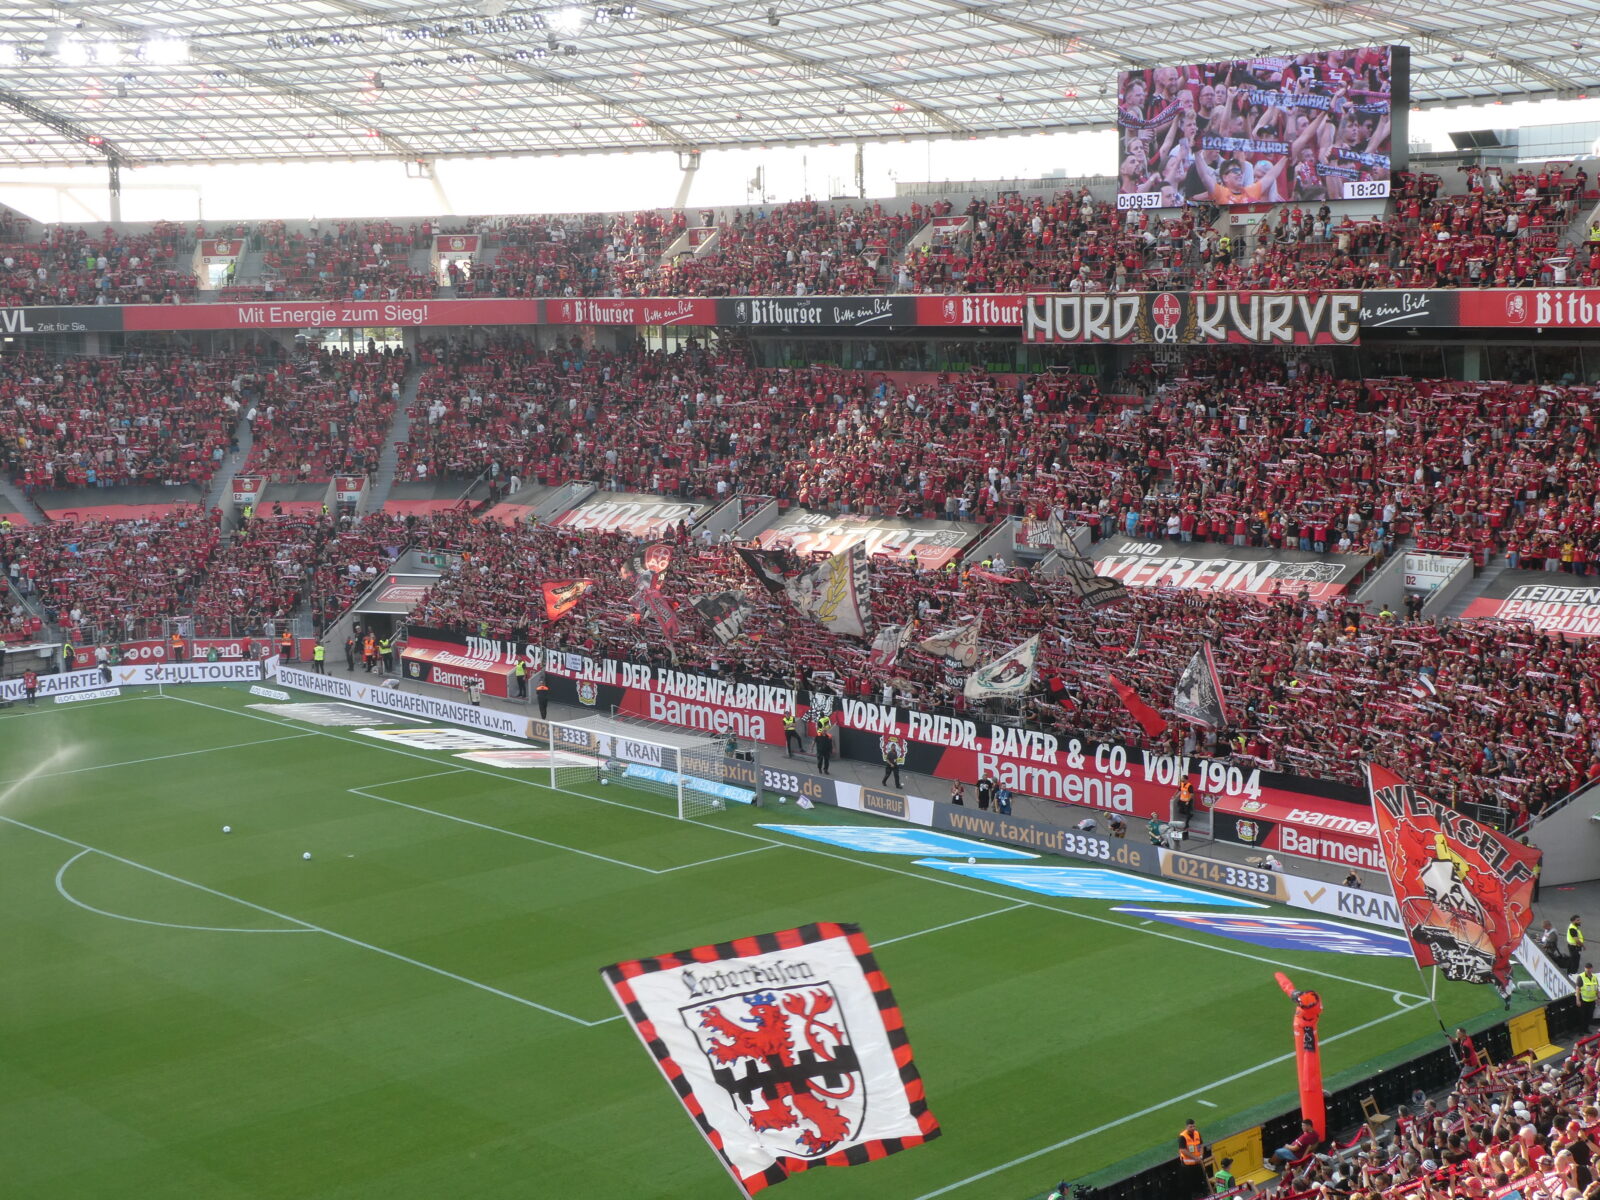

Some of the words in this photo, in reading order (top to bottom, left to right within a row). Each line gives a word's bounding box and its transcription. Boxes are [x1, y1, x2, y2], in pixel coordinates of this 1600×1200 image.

[1350, 183, 1386, 197] 18:20
[1119, 195, 1160, 209] 0:09:57
[574, 300, 635, 323] Bitburger
[643, 307, 663, 324] Bitte
[664, 308, 678, 319] ein
[678, 300, 694, 315] Bit
[751, 299, 822, 325] Bitburger
[833, 306, 856, 324] Bitte
[858, 306, 875, 319] ein
[874, 298, 893, 314] Bit
[1153, 307, 1181, 315] BAYER
[1402, 293, 1430, 312] Bit
[37, 322, 55, 332] Zeit
[56, 322, 70, 332] für
[71, 322, 88, 332] Sie.
[238, 307, 265, 323] Mit
[270, 306, 337, 327] Energie
[342, 311, 378, 322] zum
[383, 304, 429, 324] Sieg!
[1025, 295, 1141, 341] NORD
[1196, 293, 1359, 343] KURVE
[1153, 323, 1179, 344] 04
[796, 513, 832, 526] FÜR
[1118, 542, 1163, 556] UND
[1097, 556, 1282, 592] VEREIN
[1405, 575, 1417, 586] D2
[431, 650, 493, 672] Barmenia
[144, 664, 268, 682] SCHULTOUREN
[280, 669, 352, 698] BOTENFAHRTEN
[432, 665, 485, 692] Barmenia
[370, 688, 482, 726] FLUGHAFENTRANSFER
[483, 714, 517, 733] u.v.m.
[465, 635, 501, 665] TURN
[622, 662, 651, 692] DER
[657, 667, 797, 716] FARBENFABRIKEN
[841, 697, 902, 736] VORM.
[908, 709, 983, 752] FRIEDR.
[990, 722, 1059, 765] BAYER
[1066, 738, 1087, 770] &
[1095, 743, 1131, 778] CO.
[1142, 749, 1190, 787] VON
[1197, 760, 1262, 801] 1904
[648, 692, 766, 741] Barmenia
[625, 741, 660, 764] KRAN
[977, 752, 1134, 813] Barmenia
[866, 793, 903, 814] TAXI-RUF
[949, 812, 1141, 867] www.taxiruf3333.de
[1178, 857, 1270, 893] 0214-3333
[1337, 892, 1401, 923] KRAN
